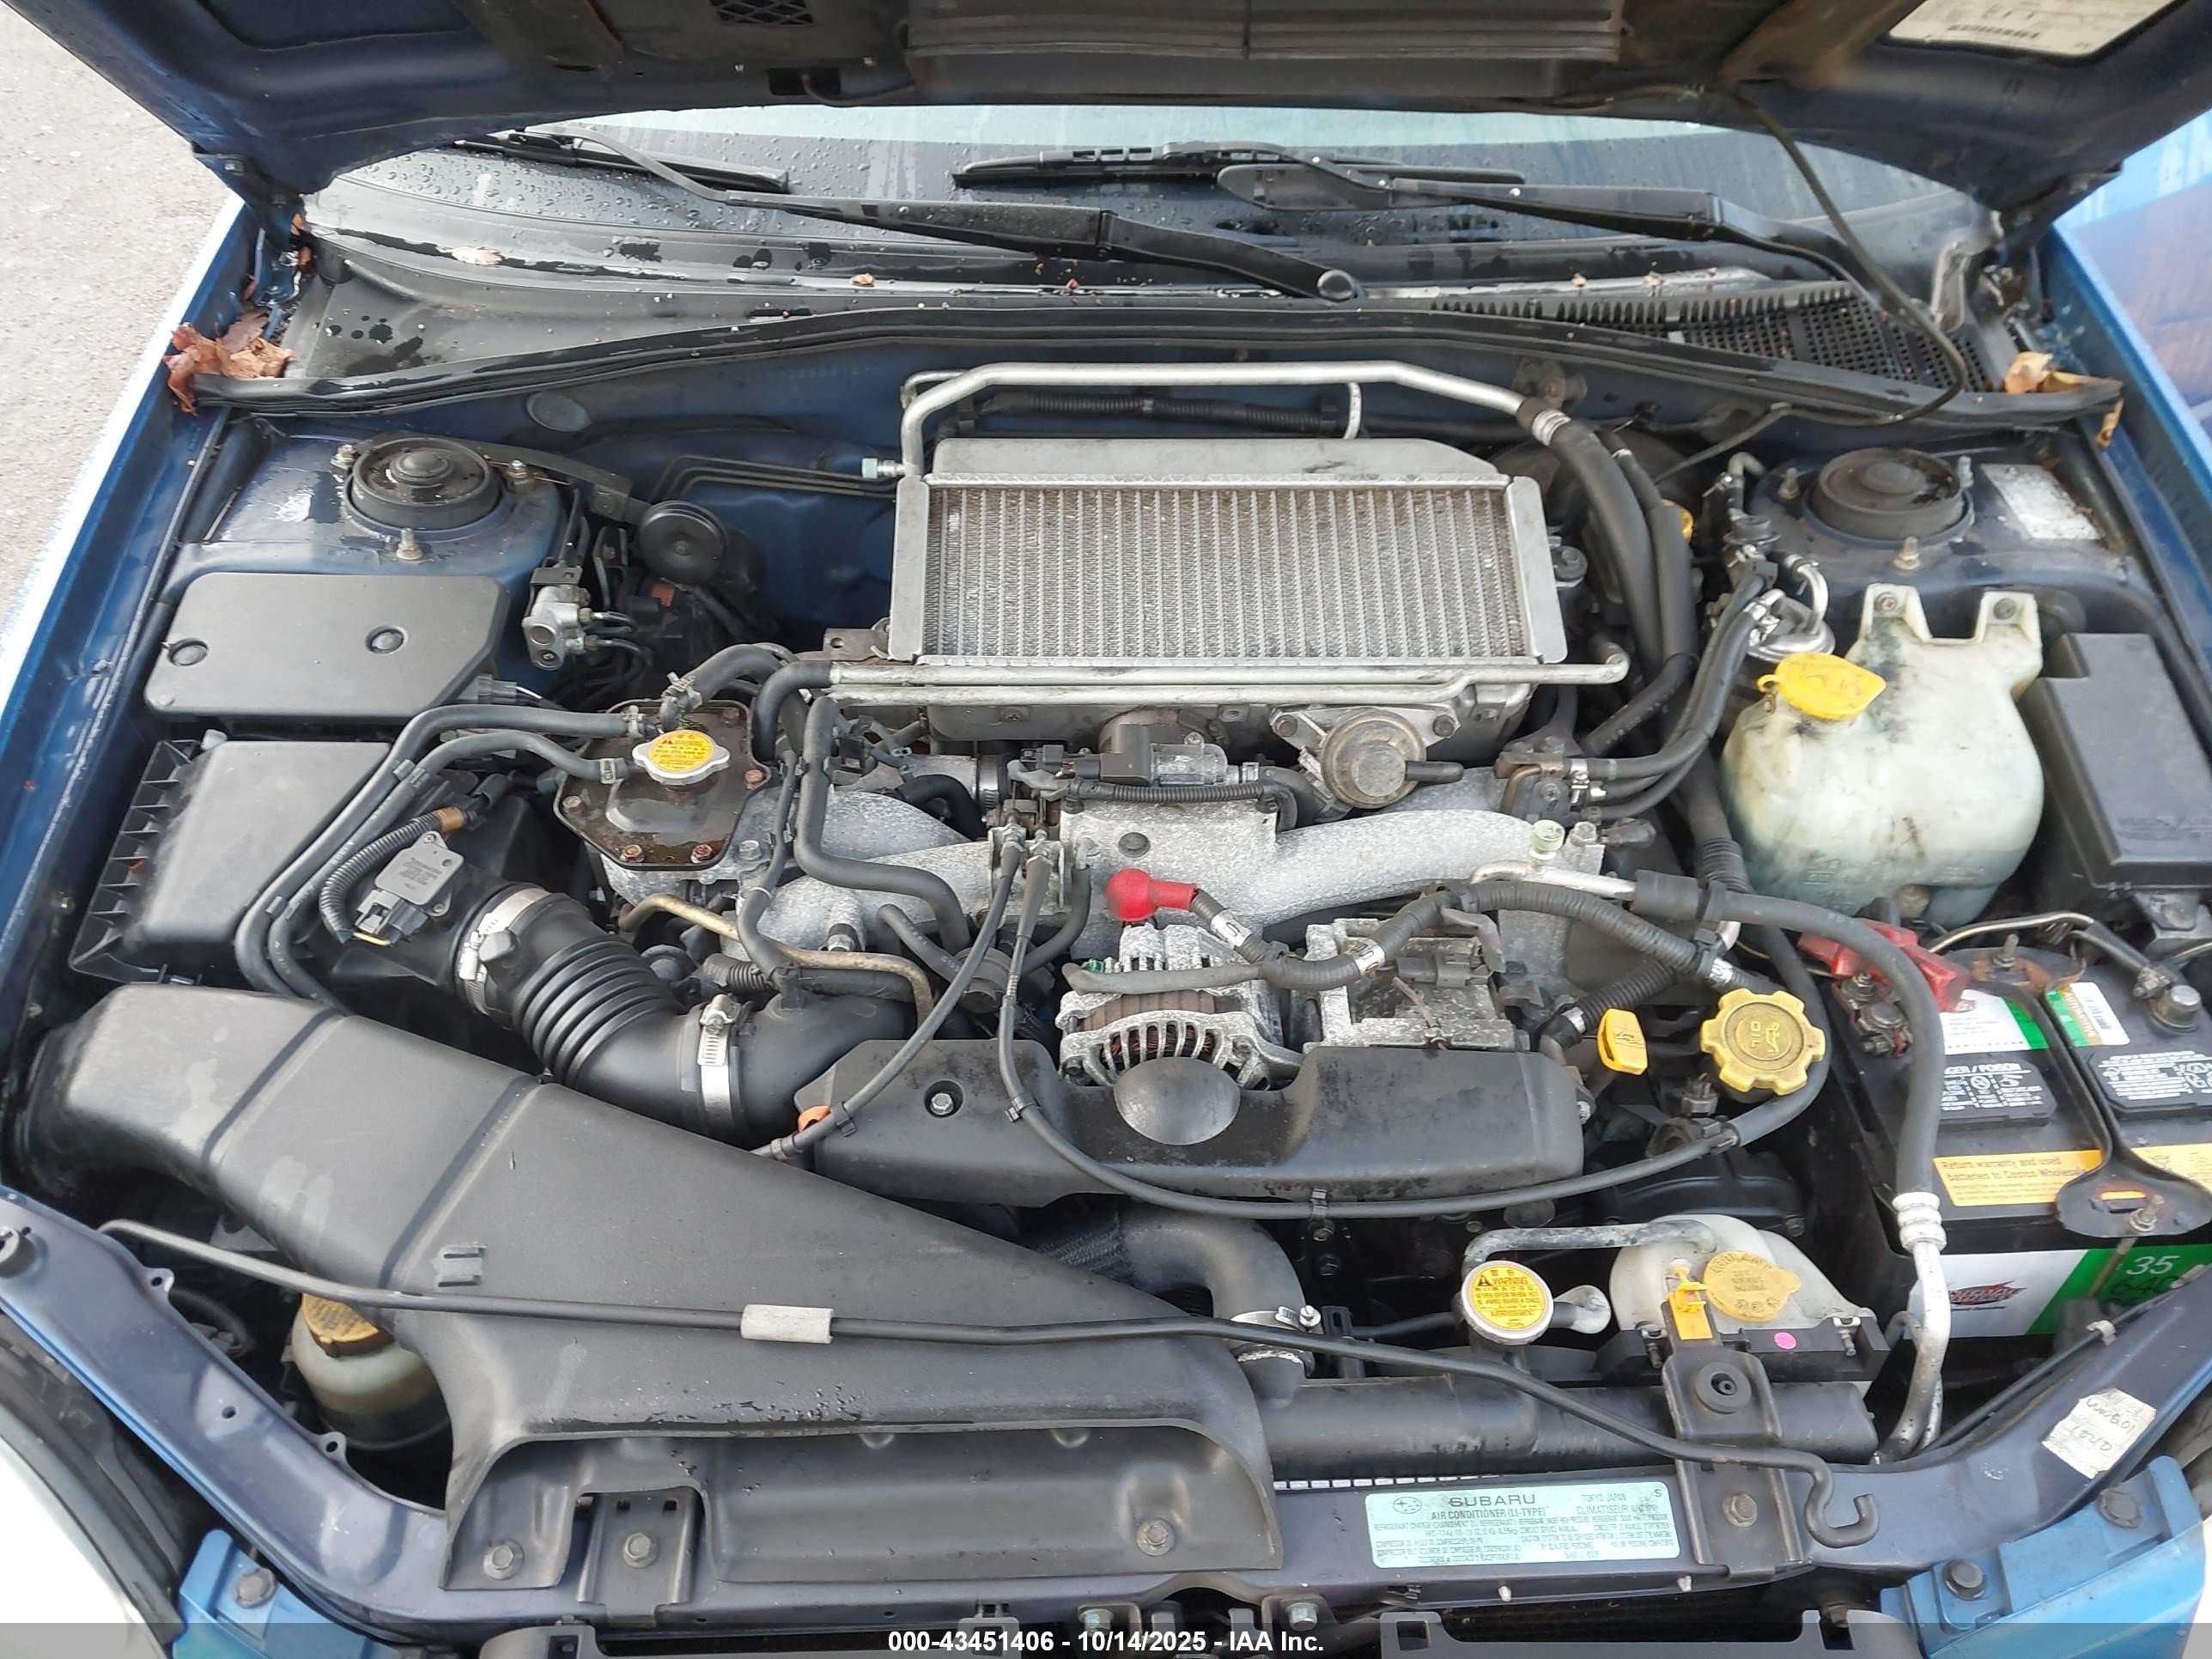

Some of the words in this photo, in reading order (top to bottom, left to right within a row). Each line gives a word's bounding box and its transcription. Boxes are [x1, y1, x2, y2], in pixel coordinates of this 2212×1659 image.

[1750, 1021, 1761, 1048] OIL
[2125, 1255, 2180, 1275] 35
[1449, 1493, 1535, 1507] SUBARU
[1654, 1489, 1662, 1498] S
[1431, 1510, 1447, 1520] AIR
[1449, 1510, 1506, 1519] CONDITIONER
